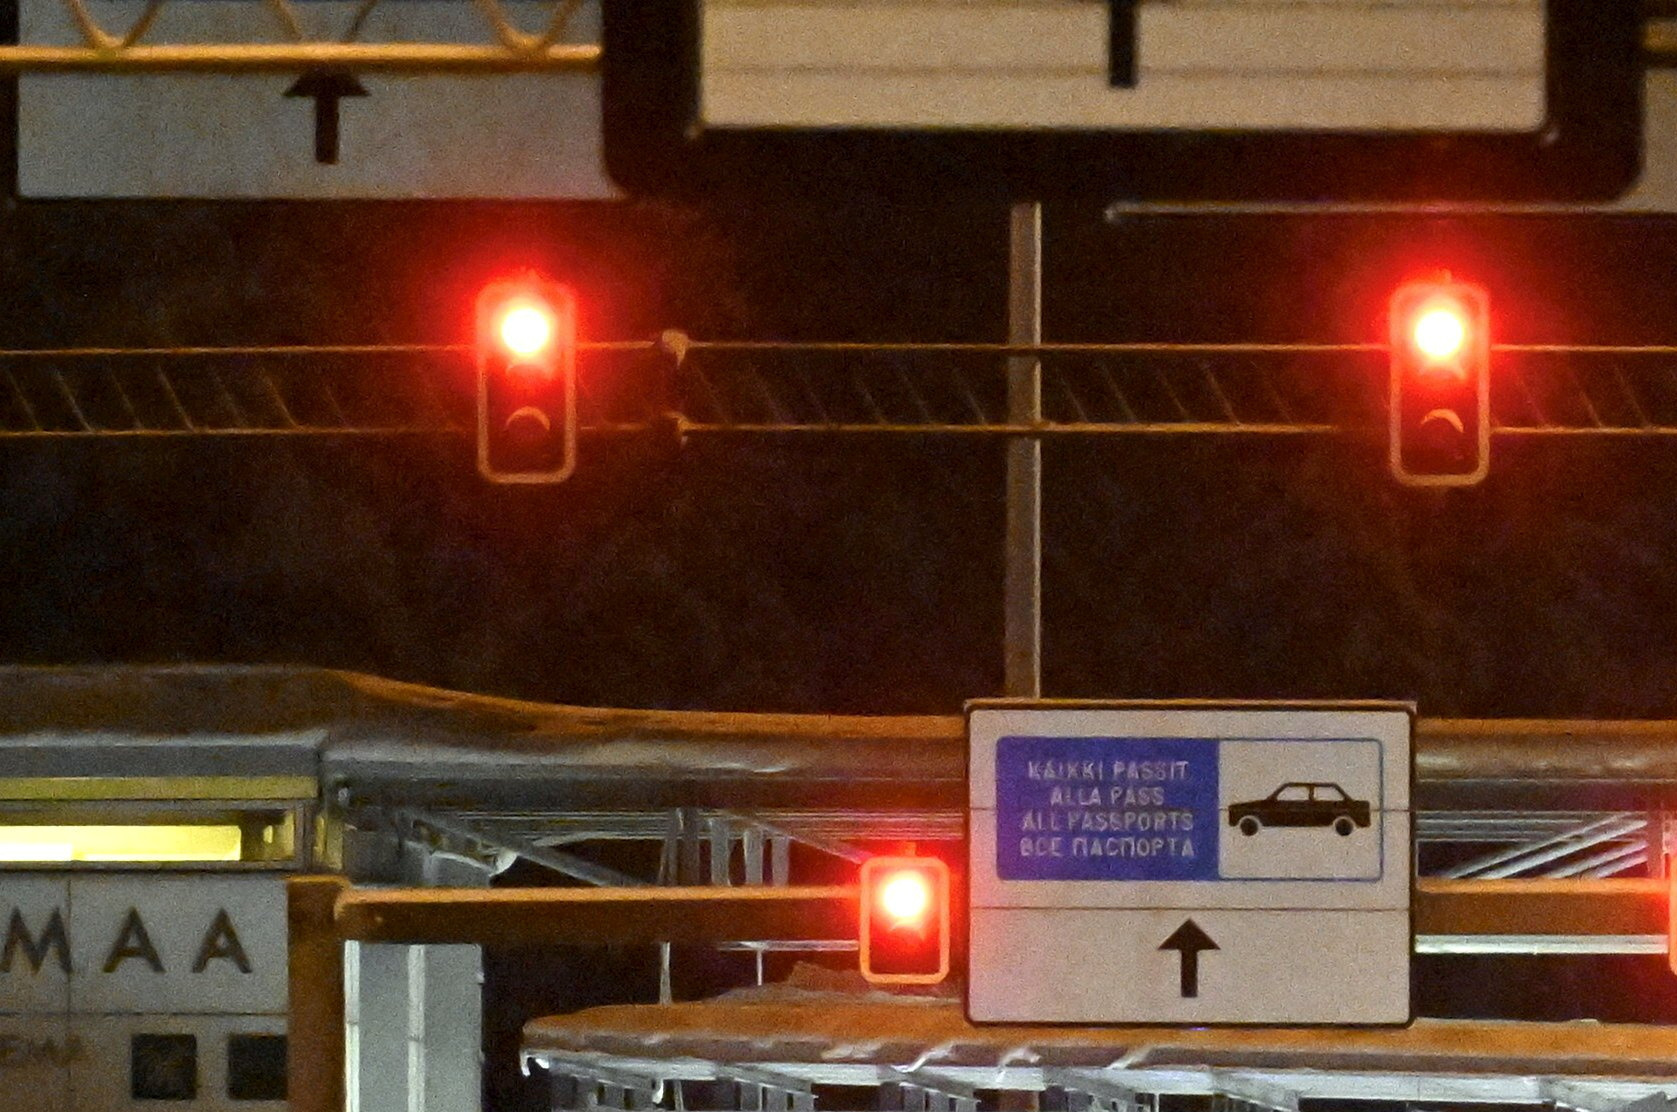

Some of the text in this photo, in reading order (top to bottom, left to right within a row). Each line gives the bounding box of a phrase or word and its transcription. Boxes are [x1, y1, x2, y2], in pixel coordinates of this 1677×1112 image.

[1028, 760, 1189, 780] KAIKKI PASSIT
[1050, 786, 1165, 806] ALLA PASS
[1022, 811, 1194, 832] ALL PASSPORTS
[1020, 837, 1195, 858] ВСЕ ПАСПОРТА
